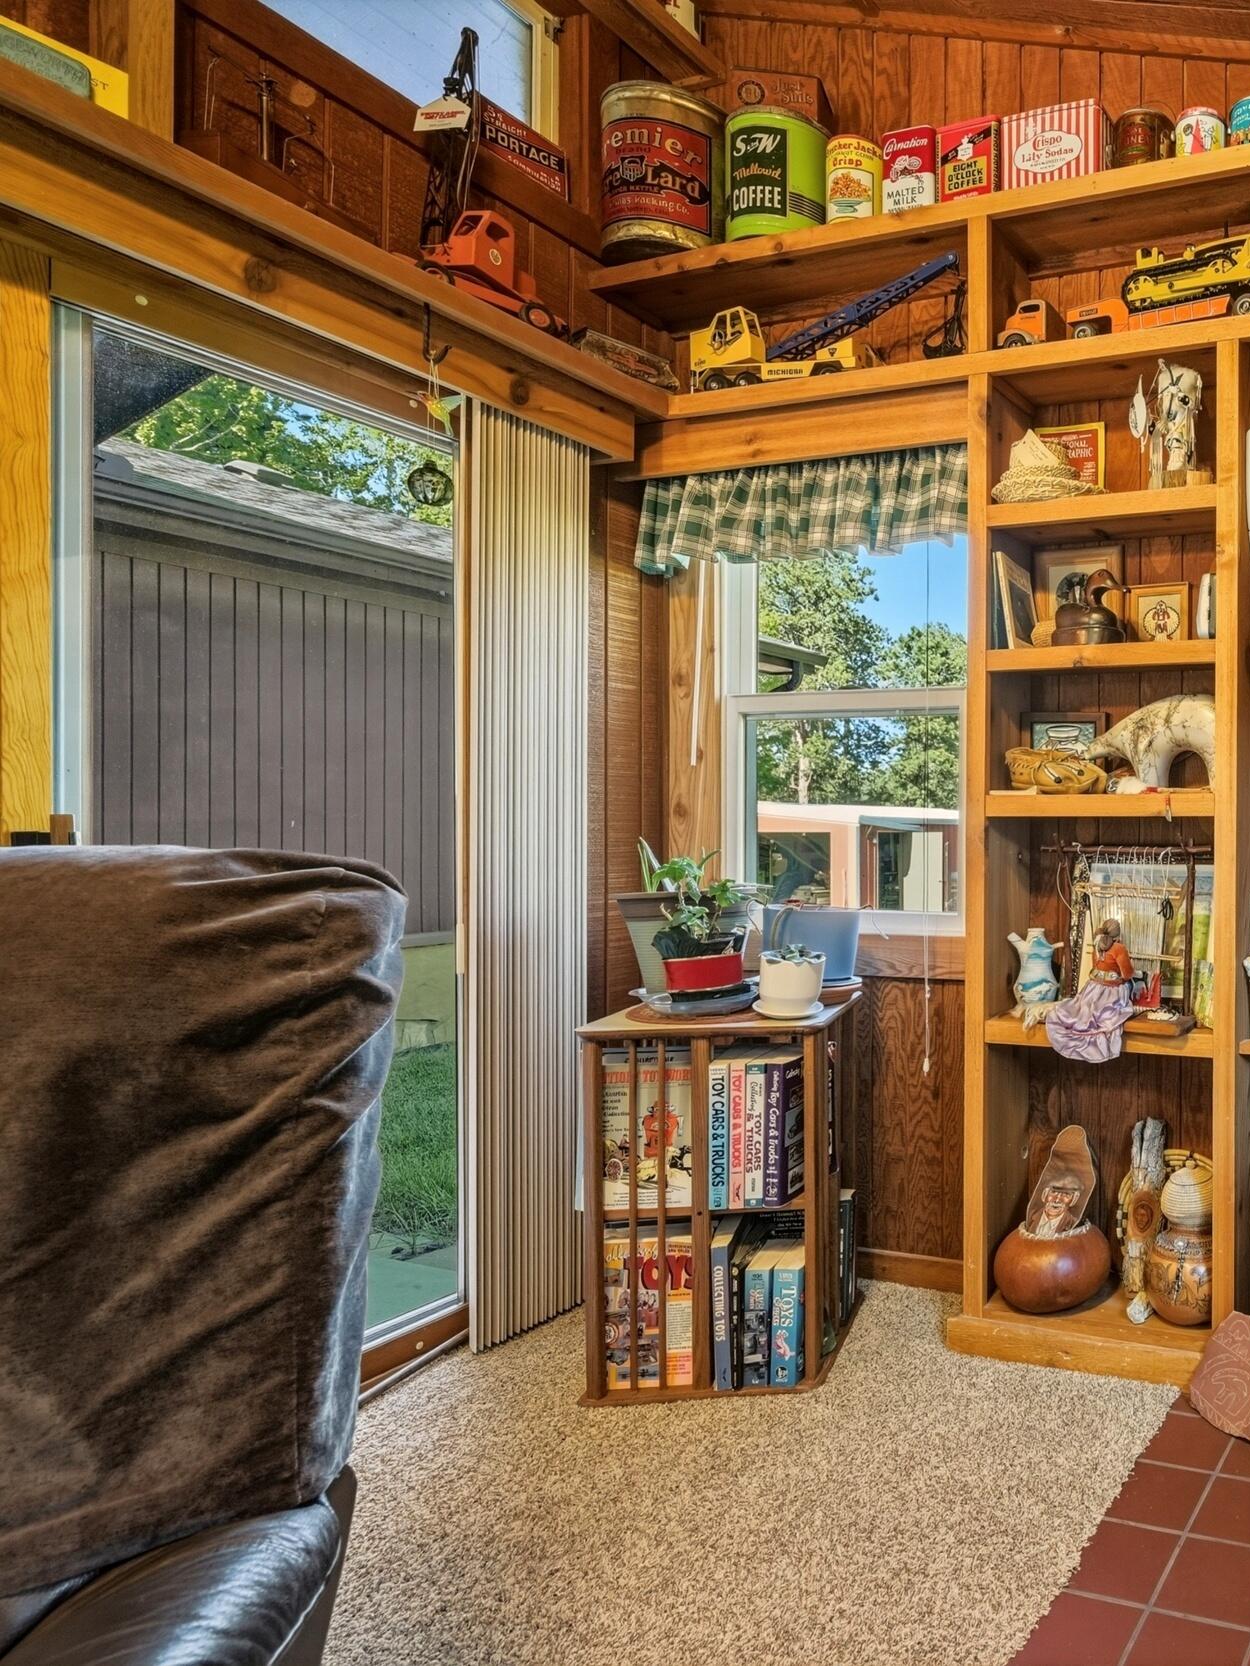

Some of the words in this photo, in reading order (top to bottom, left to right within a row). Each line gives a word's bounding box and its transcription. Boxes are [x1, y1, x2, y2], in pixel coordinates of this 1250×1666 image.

[483, 111, 528, 138] STRAIGHT
[485, 124, 560, 170] PORTAGE
[883, 137, 930, 160] Carnation
[1032, 135, 1063, 152] Crispo
[947, 168, 984, 183] O'CLOCK
[952, 160, 979, 173] EIGHT
[645, 166, 700, 198] Lard
[886, 186, 925, 200] MALTED
[947, 177, 984, 191] COFFEE
[733, 186, 782, 212] COFFEE
[893, 195, 918, 206] MILK
[767, 368, 804, 377] MICHIGAN
[711, 1076, 725, 1098] TOY
[732, 1074, 743, 1093] TOY
[732, 1095, 743, 1120] CARS
[767, 1091, 780, 1106] Toy
[711, 1101, 725, 1131] CARS
[754, 1112, 762, 1137] TOY
[711, 1133, 725, 1141] &
[732, 1133, 742, 1168] TRUCKS
[746, 1128, 754, 1173] TRUCKS
[753, 1140, 762, 1171] CARS
[711, 1142, 725, 1187] TRUCKS
[713, 1265, 725, 1318] COLLECTING
[780, 1285, 797, 1327] TOYS
[715, 1319, 726, 1342] TOYS
